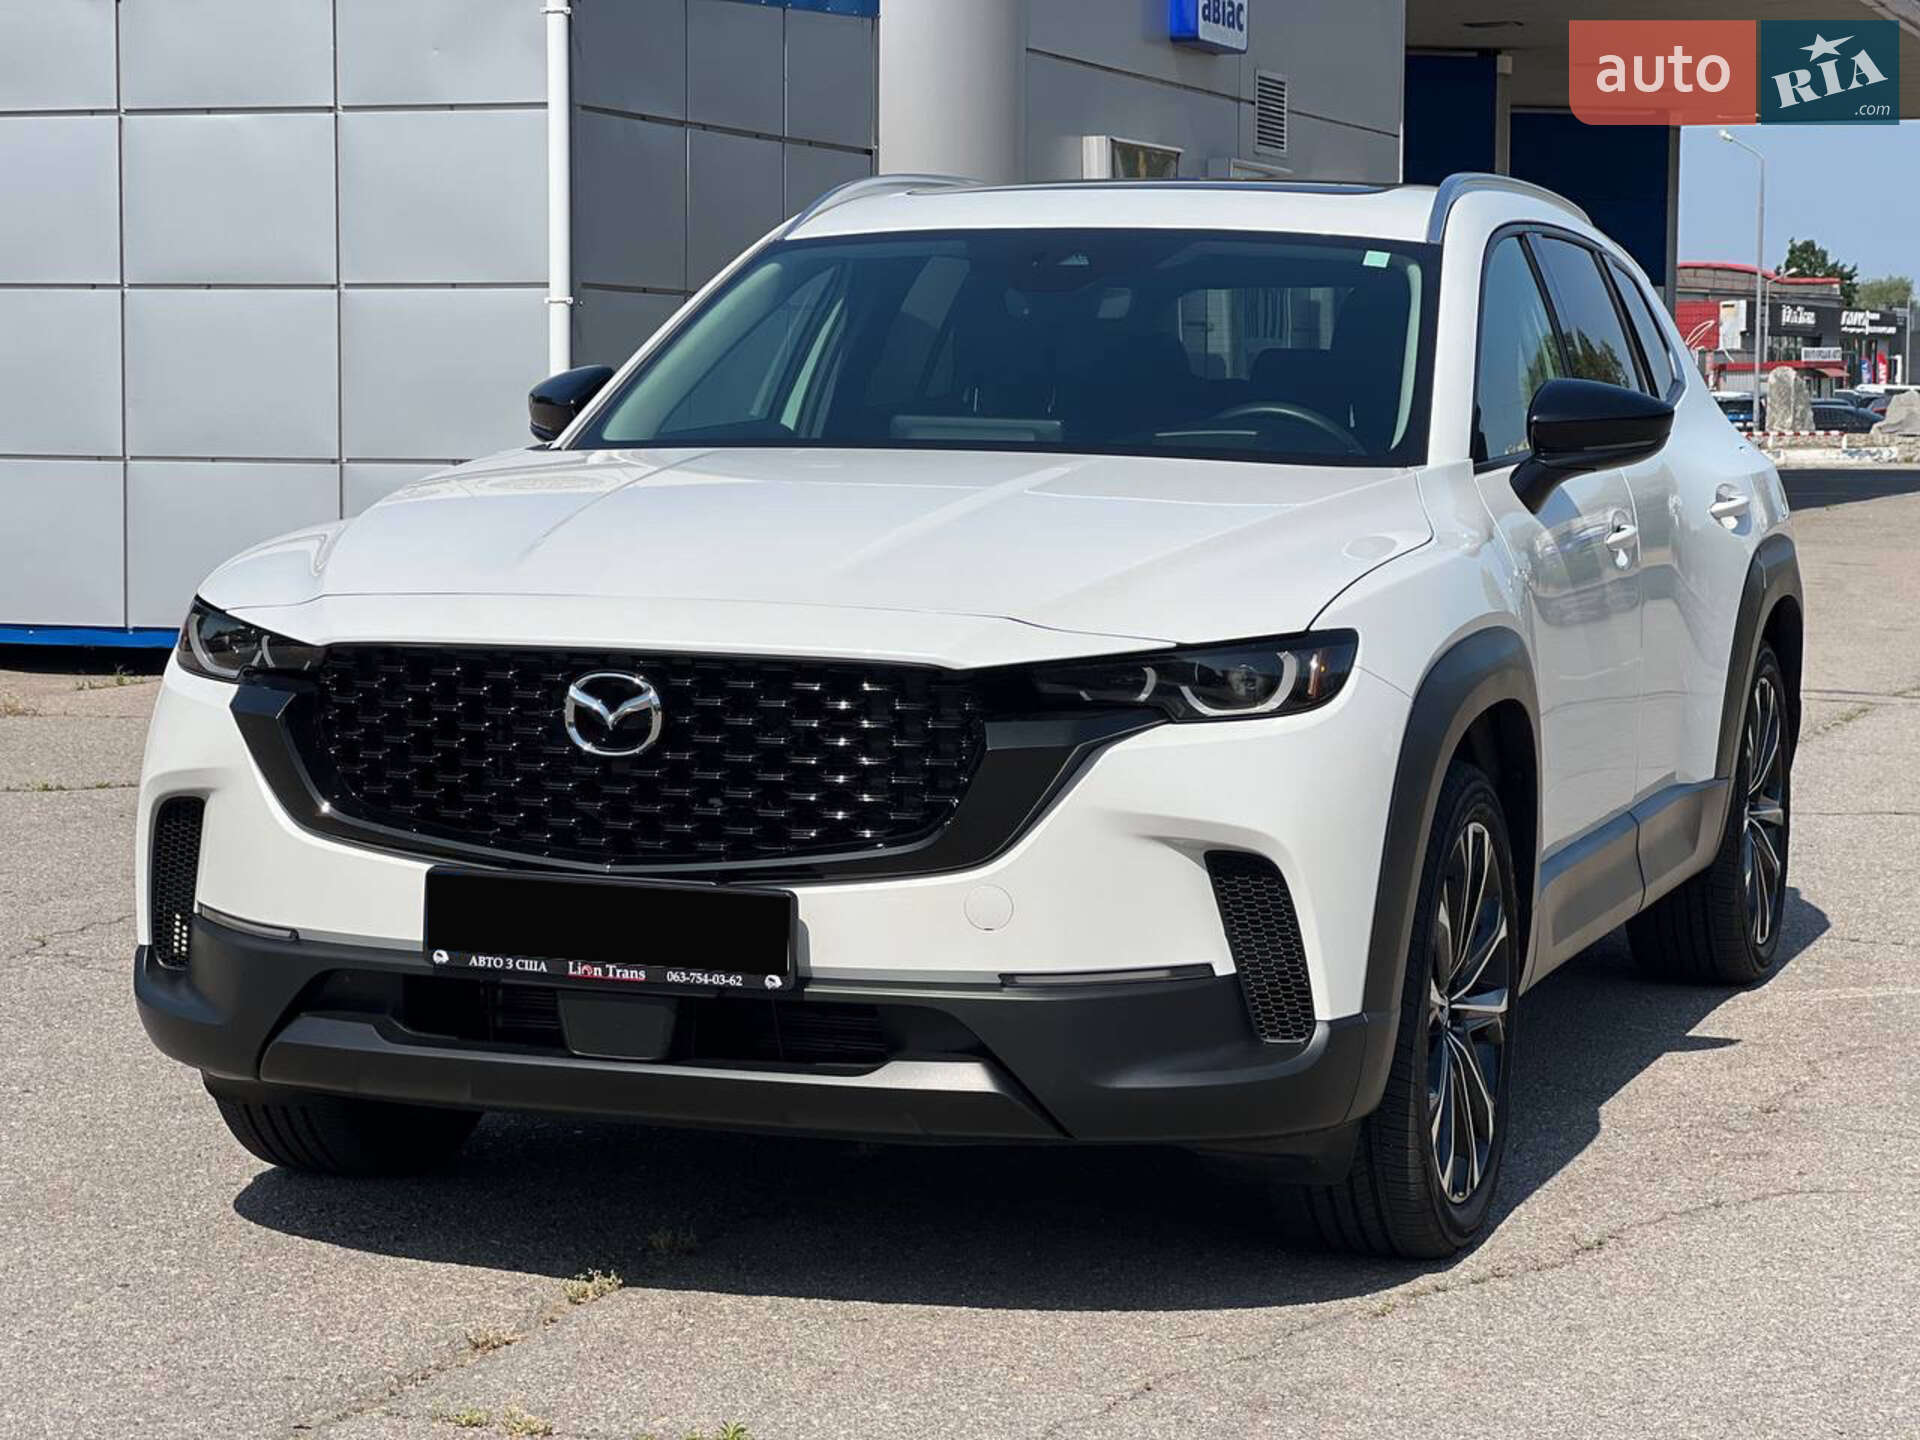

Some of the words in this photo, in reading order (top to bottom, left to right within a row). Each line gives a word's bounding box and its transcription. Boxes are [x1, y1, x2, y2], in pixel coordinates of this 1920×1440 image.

[468, 955, 504, 969] АВТО
[515, 958, 548, 973] США
[567, 960, 602, 977] Lion
[605, 963, 646, 981] Trans
[666, 970, 743, 987] 063-754-03-62
